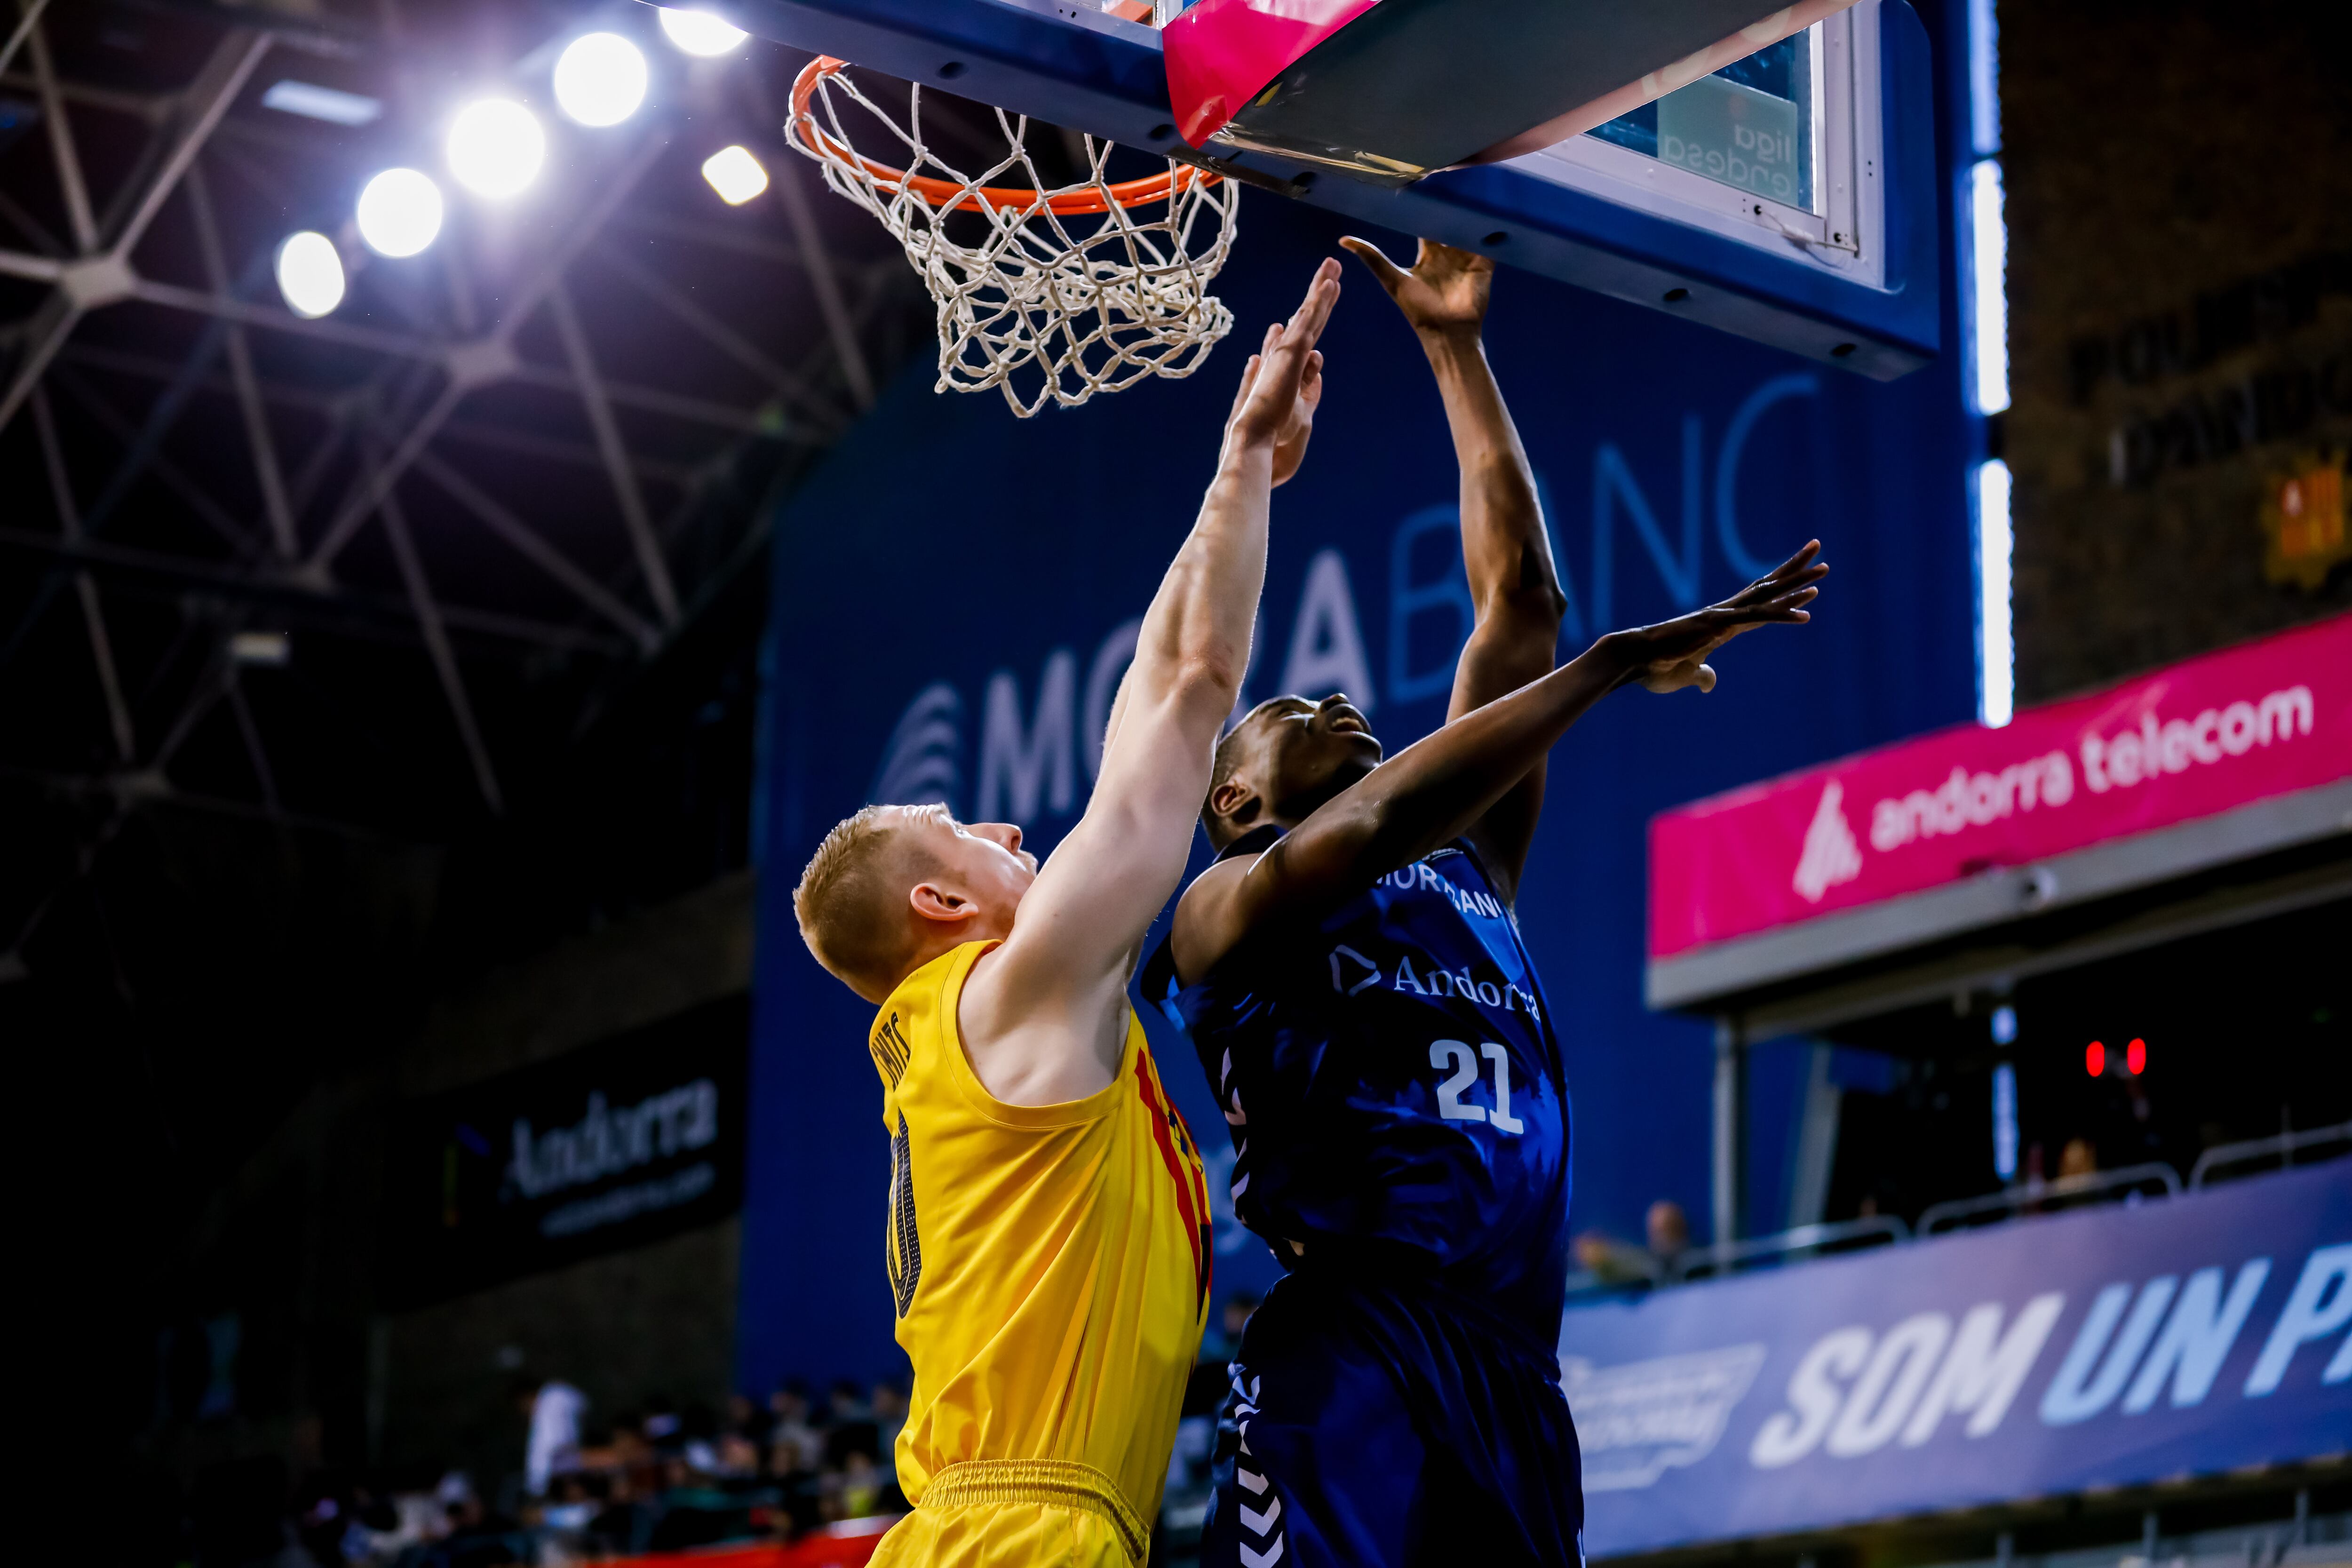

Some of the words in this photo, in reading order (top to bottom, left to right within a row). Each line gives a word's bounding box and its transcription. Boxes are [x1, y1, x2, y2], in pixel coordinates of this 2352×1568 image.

[1869, 748, 2074, 852] andorra
[2079, 685, 2314, 794] telecom
[1429, 1039, 1524, 1135] 21
[1750, 1291, 2066, 1468] SOM
[2038, 1257, 2272, 1426] UN
